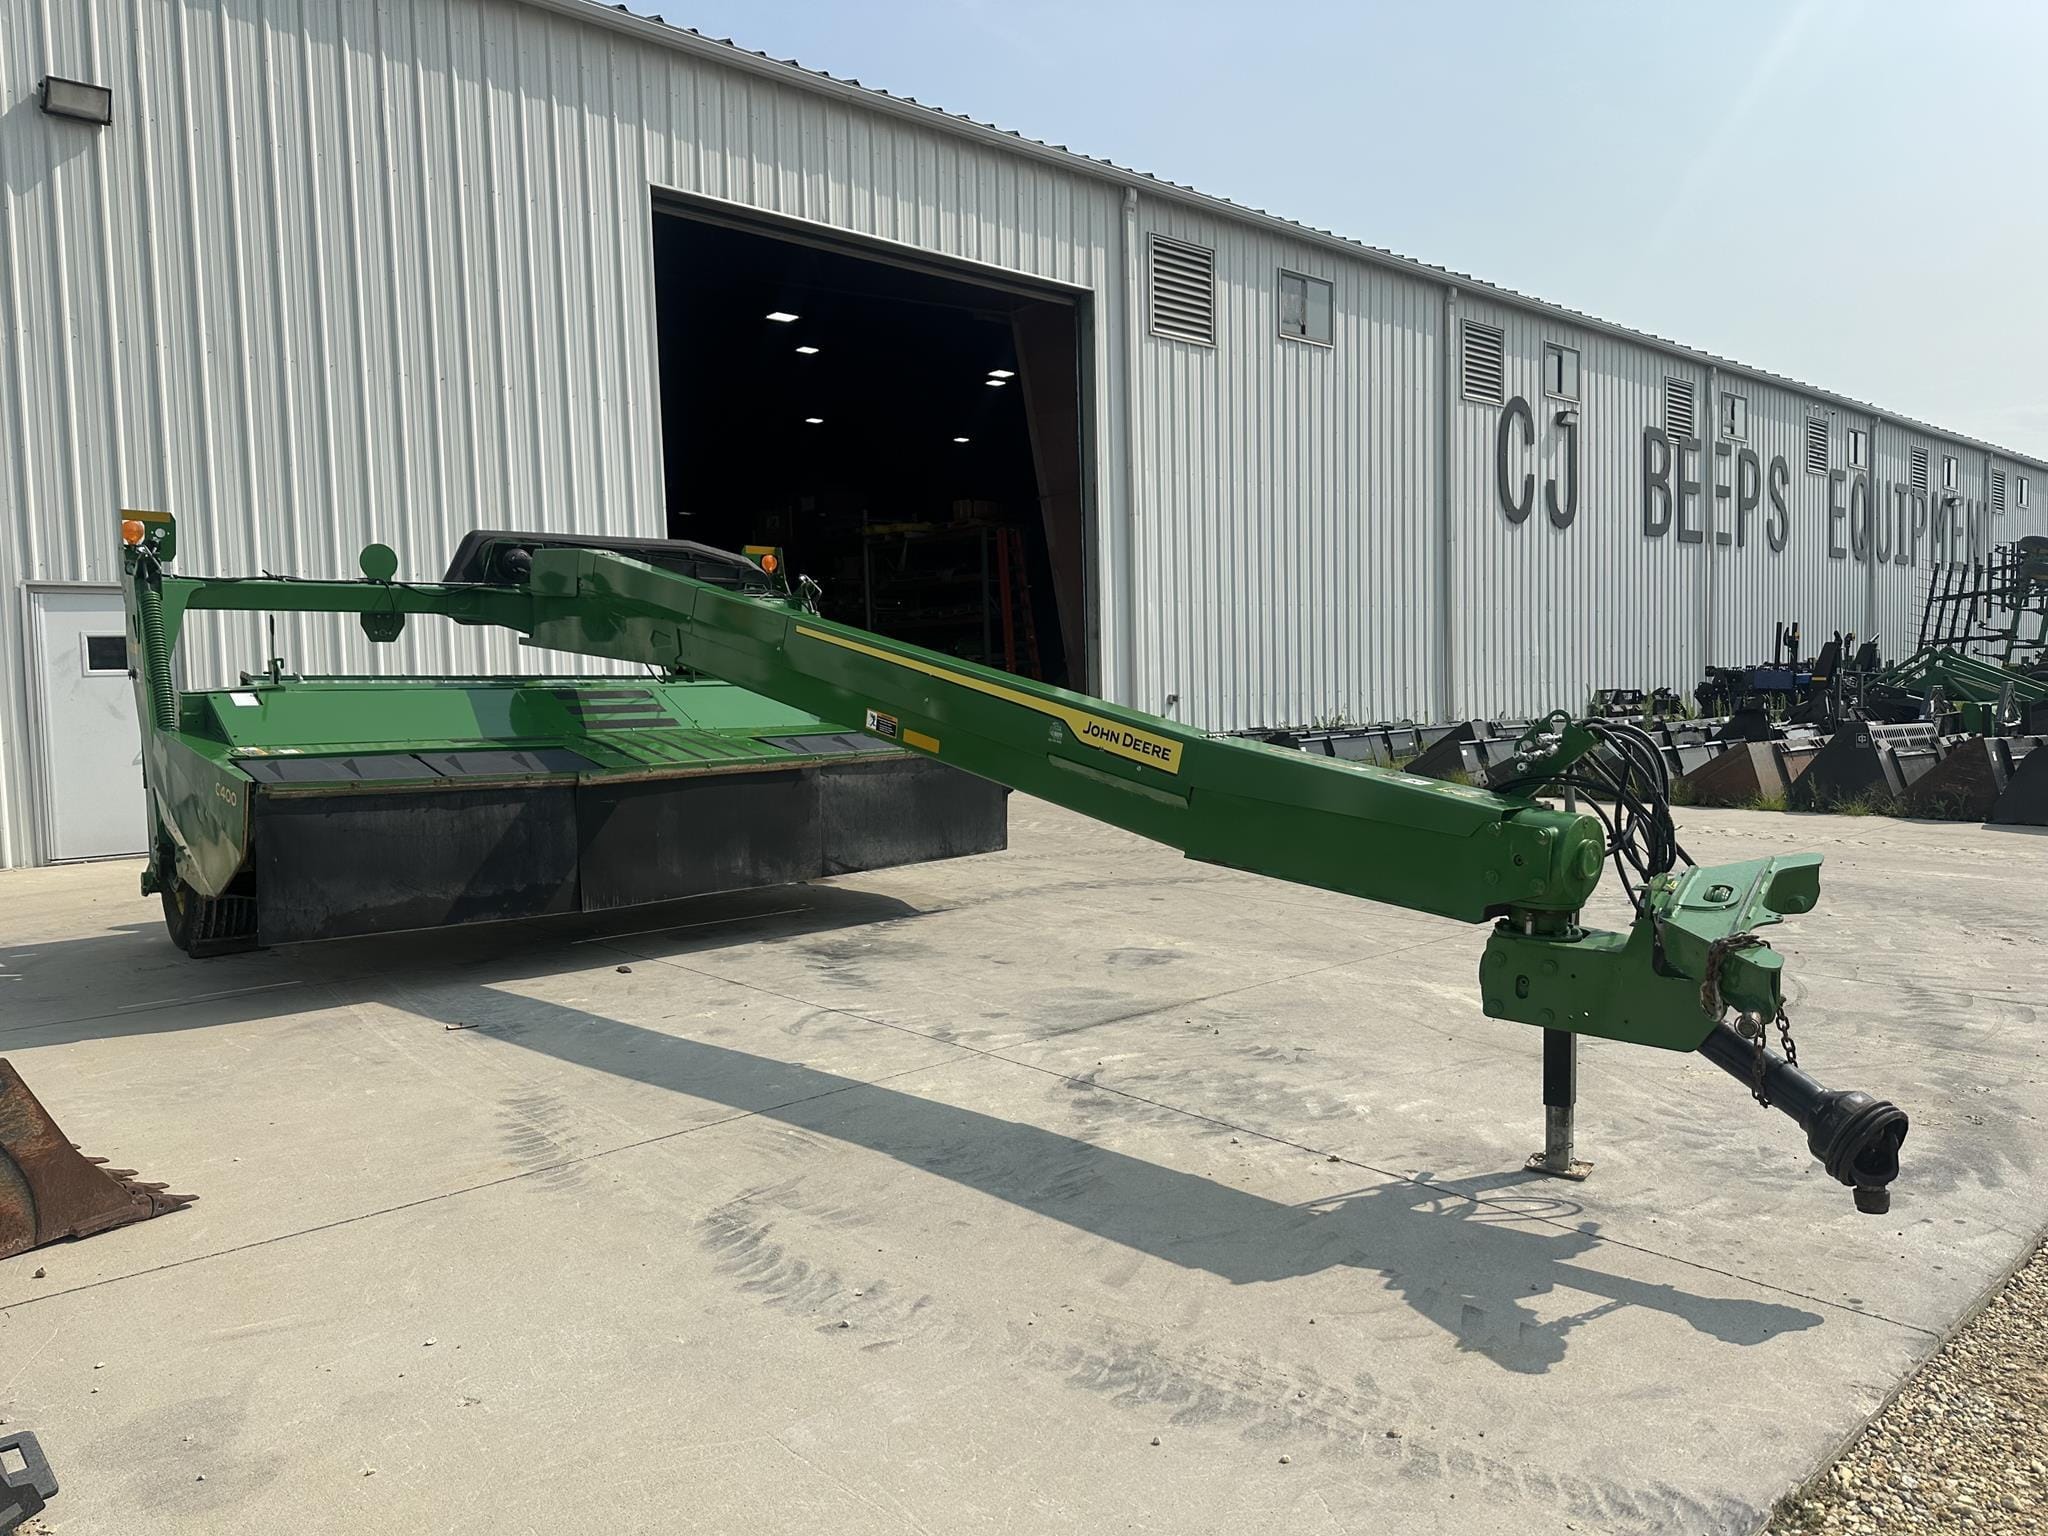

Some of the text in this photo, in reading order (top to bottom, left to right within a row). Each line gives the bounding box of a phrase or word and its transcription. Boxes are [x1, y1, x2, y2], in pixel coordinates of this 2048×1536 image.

[1498, 396, 1578, 530] CJ
[1644, 425, 1790, 553] BEEPS
[1083, 720, 1121, 745] JOHN
[1122, 732, 1172, 762] DEERE
